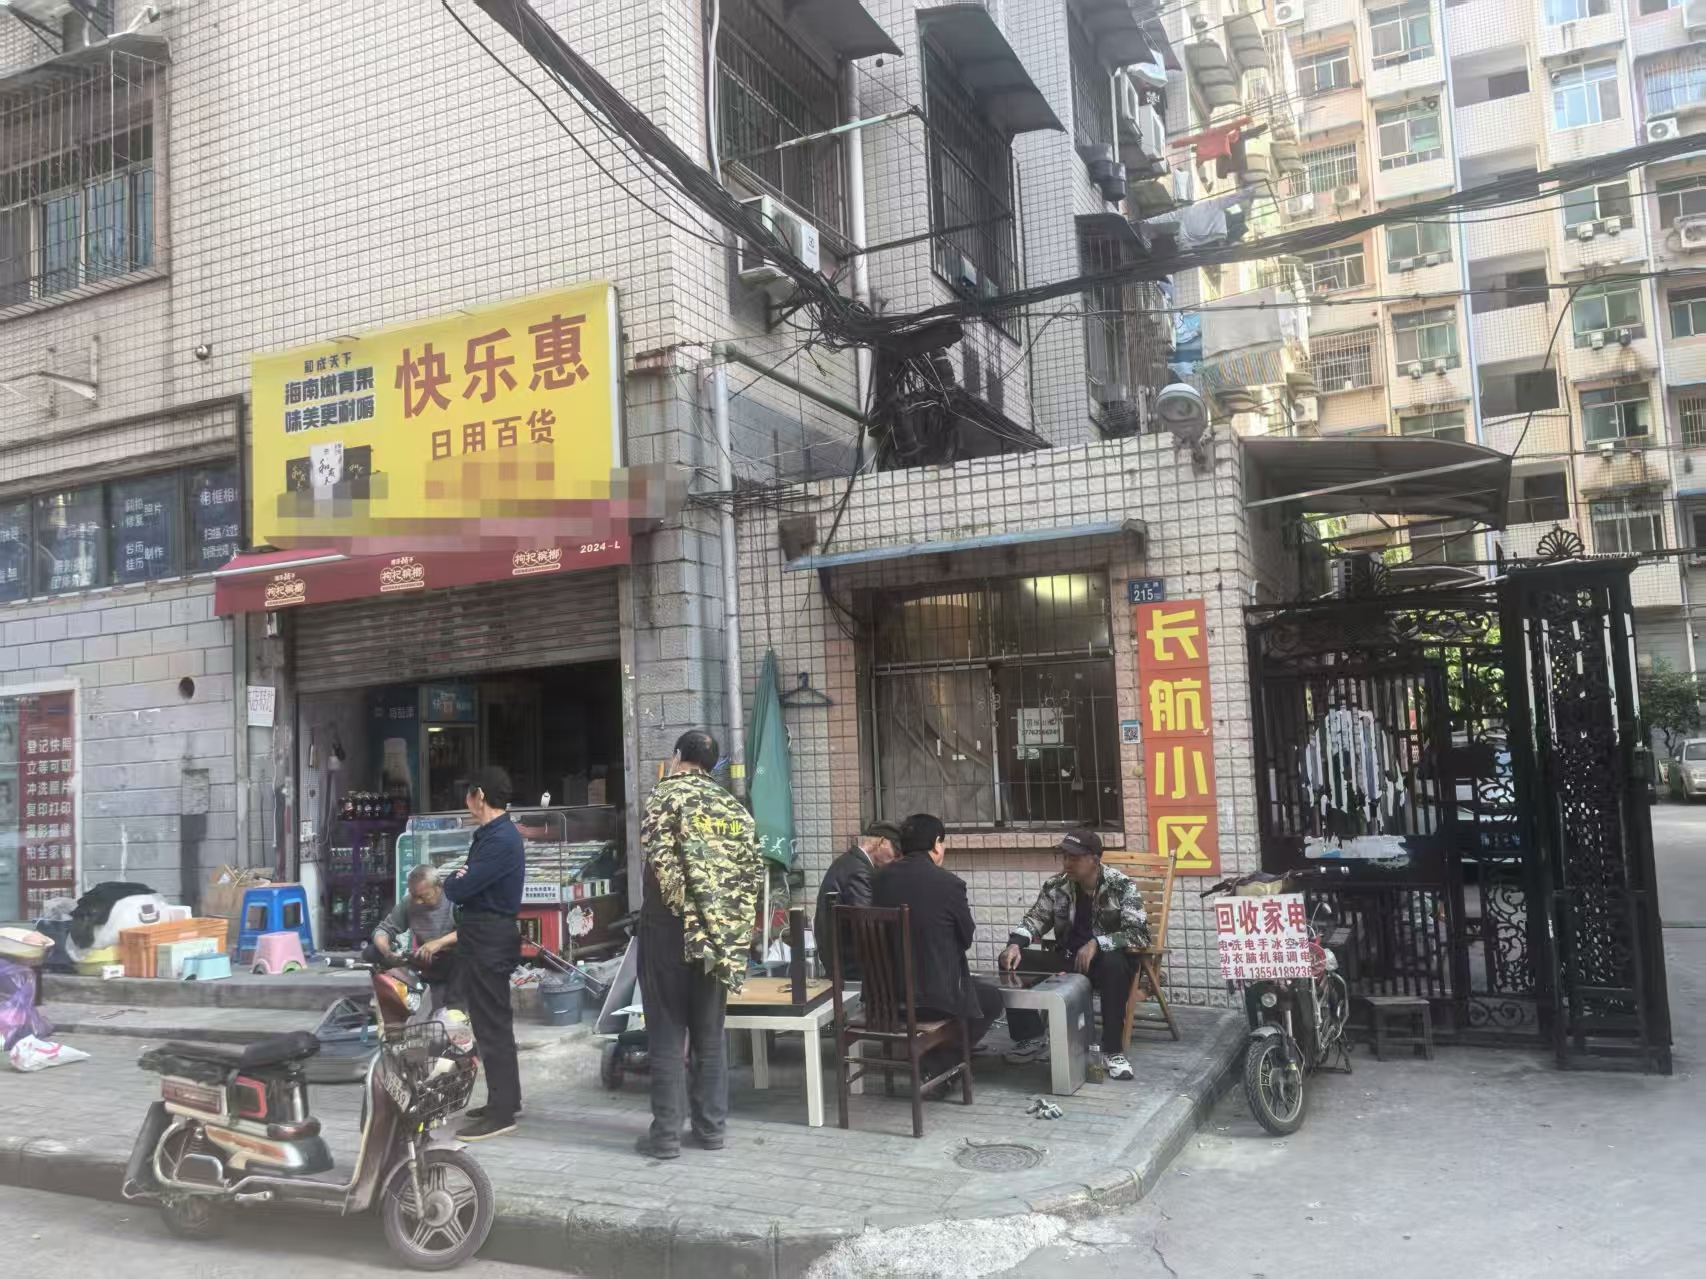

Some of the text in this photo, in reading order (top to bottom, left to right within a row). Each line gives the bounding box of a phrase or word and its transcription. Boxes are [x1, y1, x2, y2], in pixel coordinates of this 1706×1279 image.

[394, 314, 590, 419] 快乐惠
[285, 366, 374, 405] 海南嫩青果
[285, 394, 374, 433] 味美更耐嚼
[432, 408, 556, 460] 日用百货
[514, 548, 561, 565] 枸杞槟榔
[381, 566, 423, 582] 枸杞槟榔
[266, 582, 305, 599] 枸杞槟榔
[1134, 589, 1154, 601] 215
[27, 738, 72, 755] 登记快照
[1146, 609, 1212, 869] 长航小区
[27, 759, 72, 776] 立等可取
[27, 780, 72, 797] 冲洗照片
[27, 800, 72, 818] 复印打印
[1215, 898, 1307, 935] 回收家电
